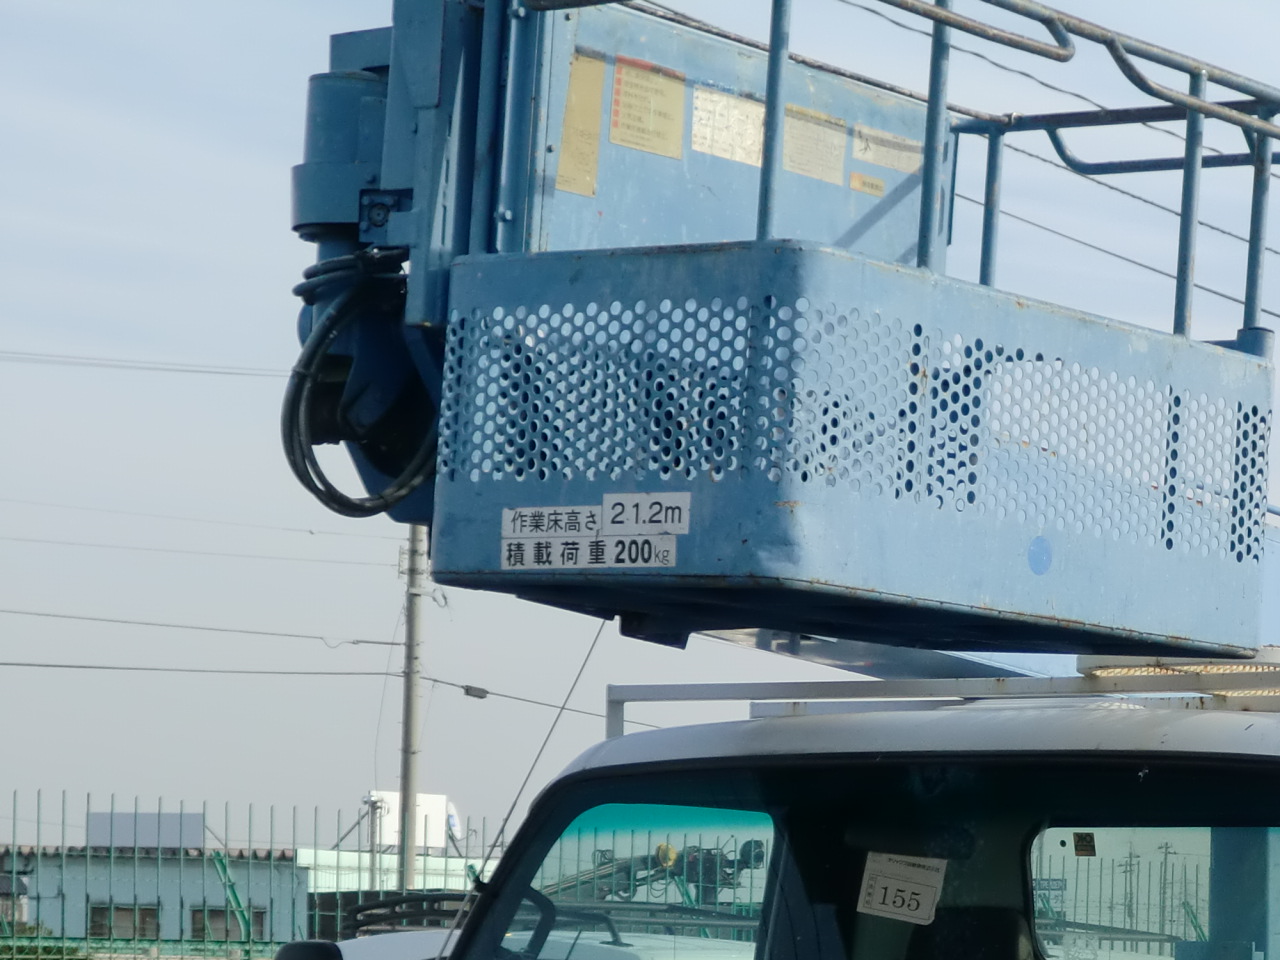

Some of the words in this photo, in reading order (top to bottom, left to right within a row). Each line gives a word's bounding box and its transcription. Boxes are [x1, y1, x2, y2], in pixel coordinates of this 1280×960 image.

[510, 509, 598, 533] 作業床高さ
[610, 501, 682, 525] 21.2m
[505, 539, 607, 567] 積載荷重
[878, 886, 921, 912] 155
